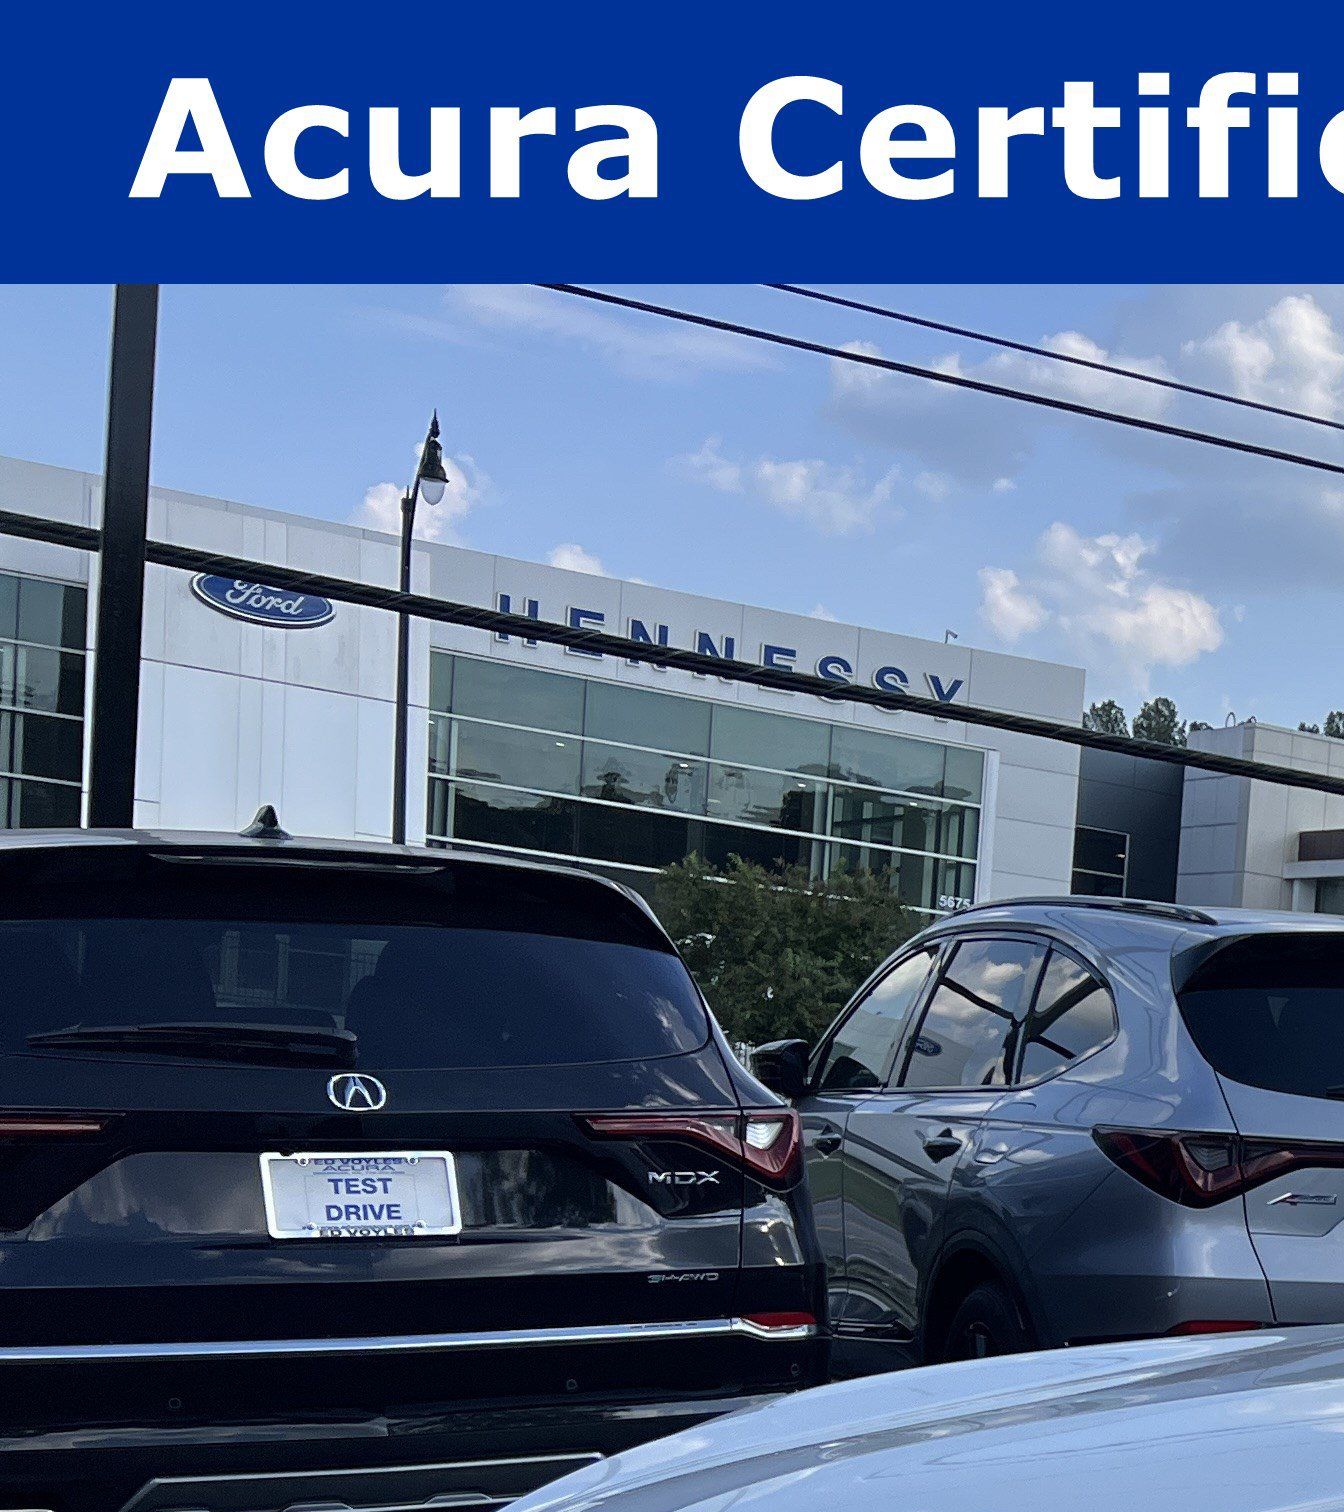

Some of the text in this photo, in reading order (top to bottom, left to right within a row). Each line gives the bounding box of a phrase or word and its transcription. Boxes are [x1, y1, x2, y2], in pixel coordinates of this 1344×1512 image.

[225, 580, 303, 615] Ford
[494, 592, 964, 722] HENNESSY
[328, 1178, 392, 1195] TEST
[648, 1170, 720, 1185] MDX
[325, 1203, 402, 1221] DRIVE
